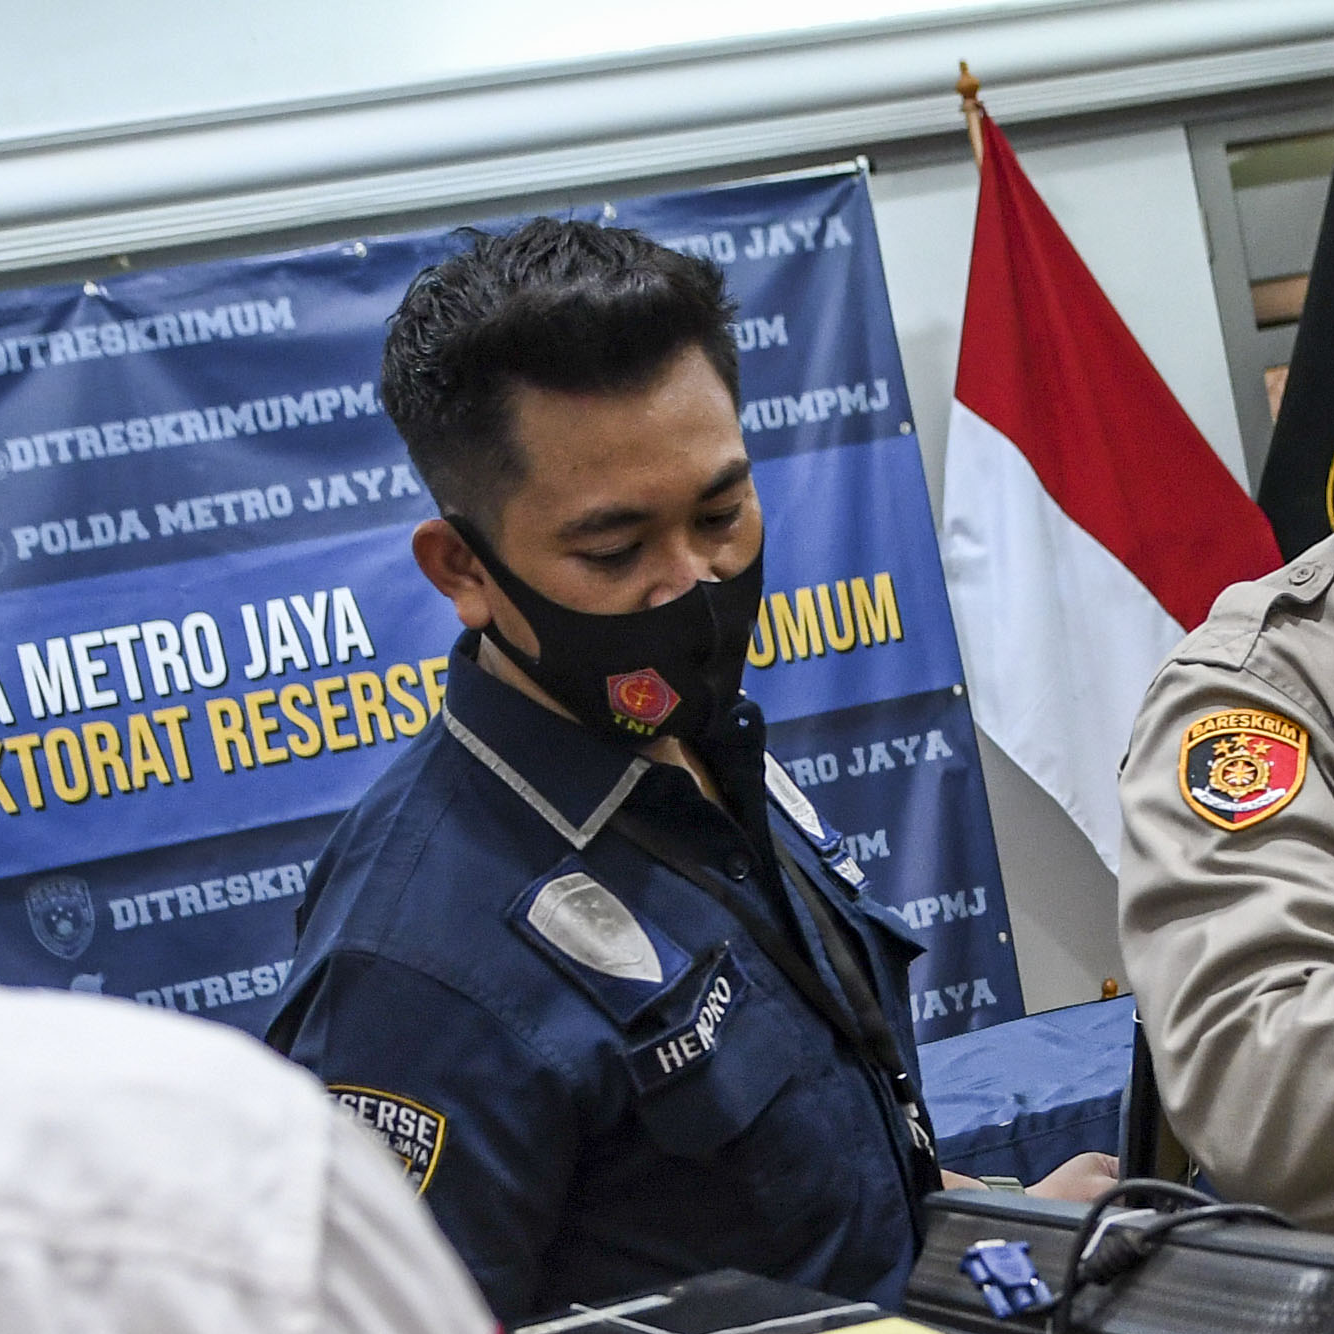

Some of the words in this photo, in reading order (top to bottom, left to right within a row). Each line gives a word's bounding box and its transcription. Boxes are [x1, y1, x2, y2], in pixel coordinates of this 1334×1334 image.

[744, 216, 852, 260] JAYA
[11, 509, 149, 560] POLDA
[154, 484, 294, 536] METRO
[303, 464, 421, 512] JAYA
[17, 611, 230, 720] METRO
[240, 587, 376, 681] JAYA
[205, 656, 448, 774] RESERSE
[847, 730, 953, 776] JAYA
[1191, 715, 1297, 741] BARESKRIM
[656, 976, 732, 1073] HENDRO
